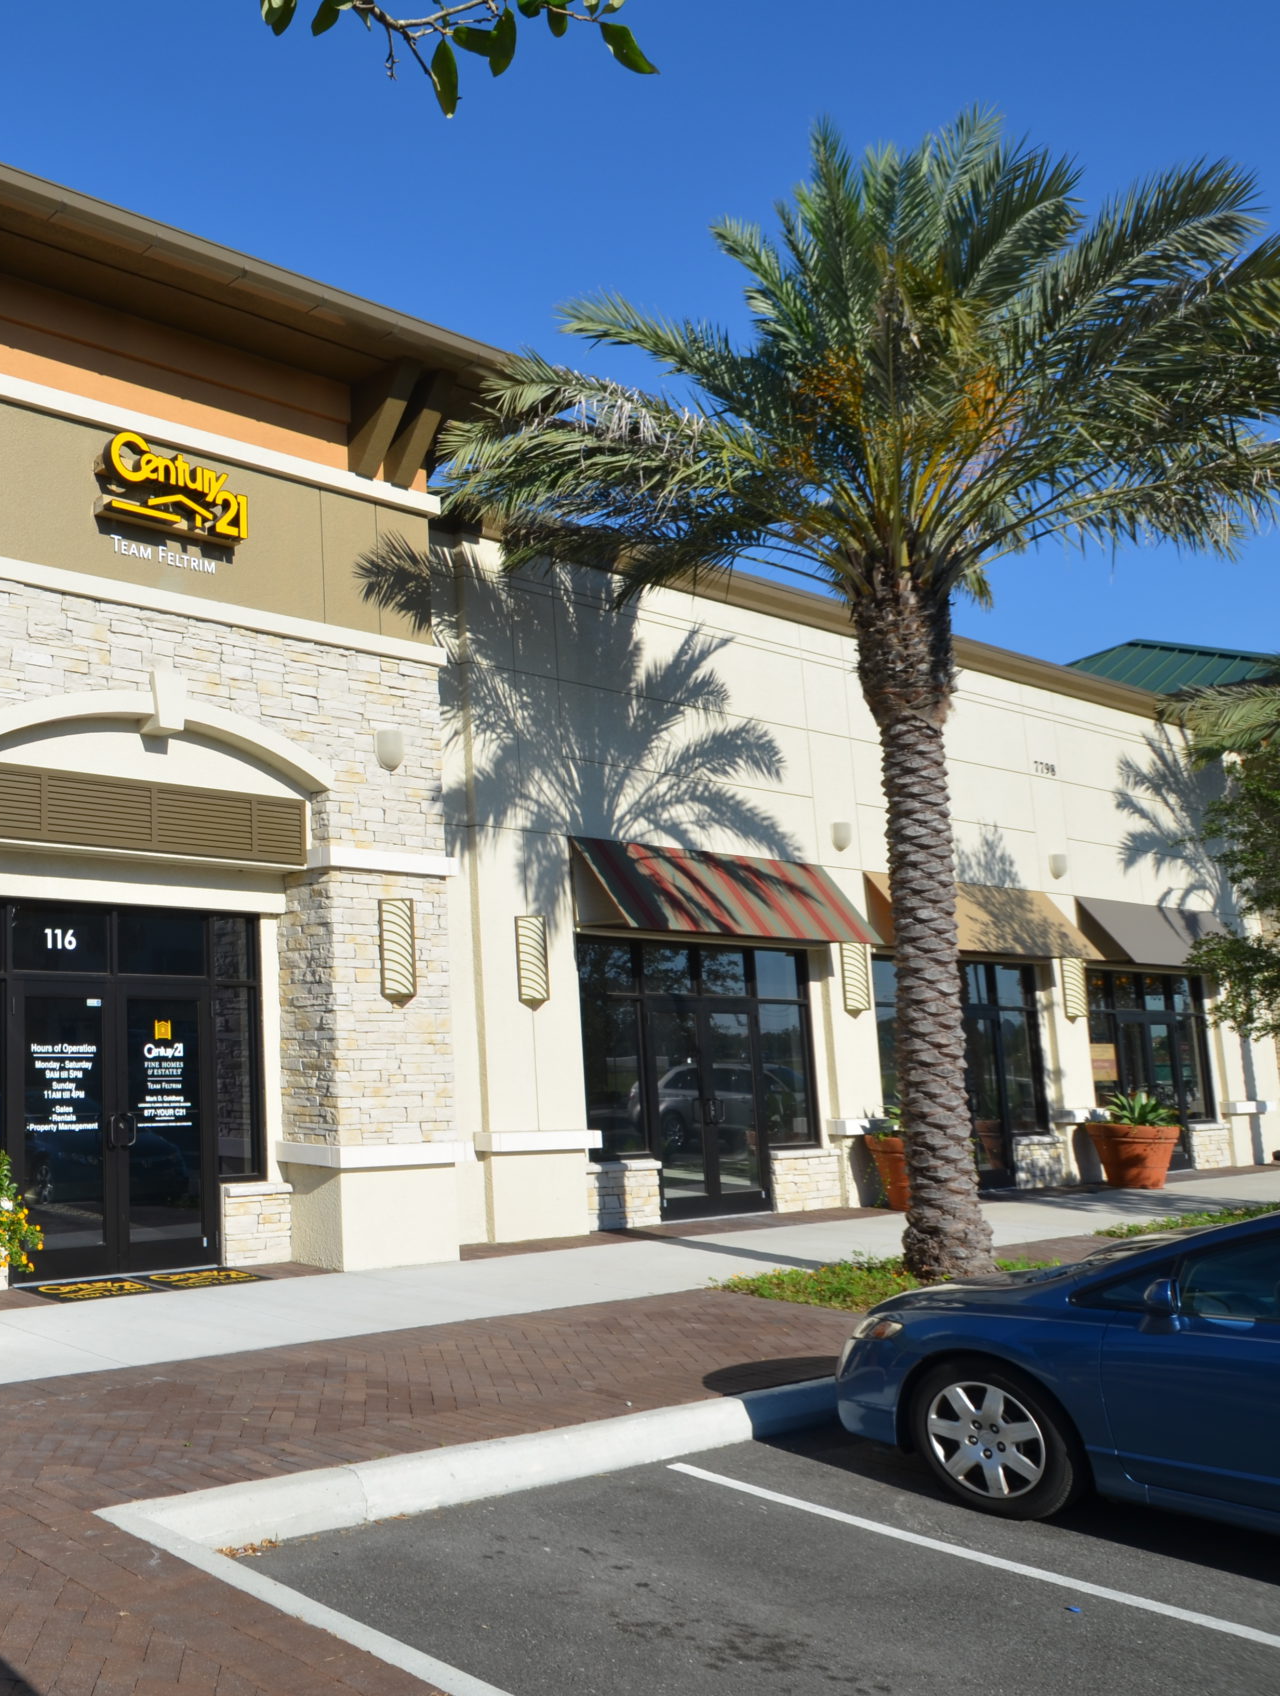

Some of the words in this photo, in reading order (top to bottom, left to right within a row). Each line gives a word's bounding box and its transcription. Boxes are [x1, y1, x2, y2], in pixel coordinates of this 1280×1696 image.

[111, 431, 228, 502] Century
[215, 490, 248, 539] 21
[110, 534, 152, 560] TEAM
[158, 545, 216, 574] FELTRIM
[1033, 760, 1056, 776] 7798
[44, 928, 77, 950] 116
[31, 1043, 53, 1053] Hours
[54, 1043, 62, 1053] of
[63, 1043, 97, 1055] Operation
[35, 1061, 61, 1070] Monday
[65, 1060, 93, 1070] Saturday
[45, 1070, 60, 1079] 9AM
[69, 1070, 83, 1079] 5PM
[52, 1081, 76, 1092] Sunday
[43, 1091, 62, 1099] 11AM
[71, 1091, 85, 1099] 4PM
[58, 1122, 98, 1132] Management
